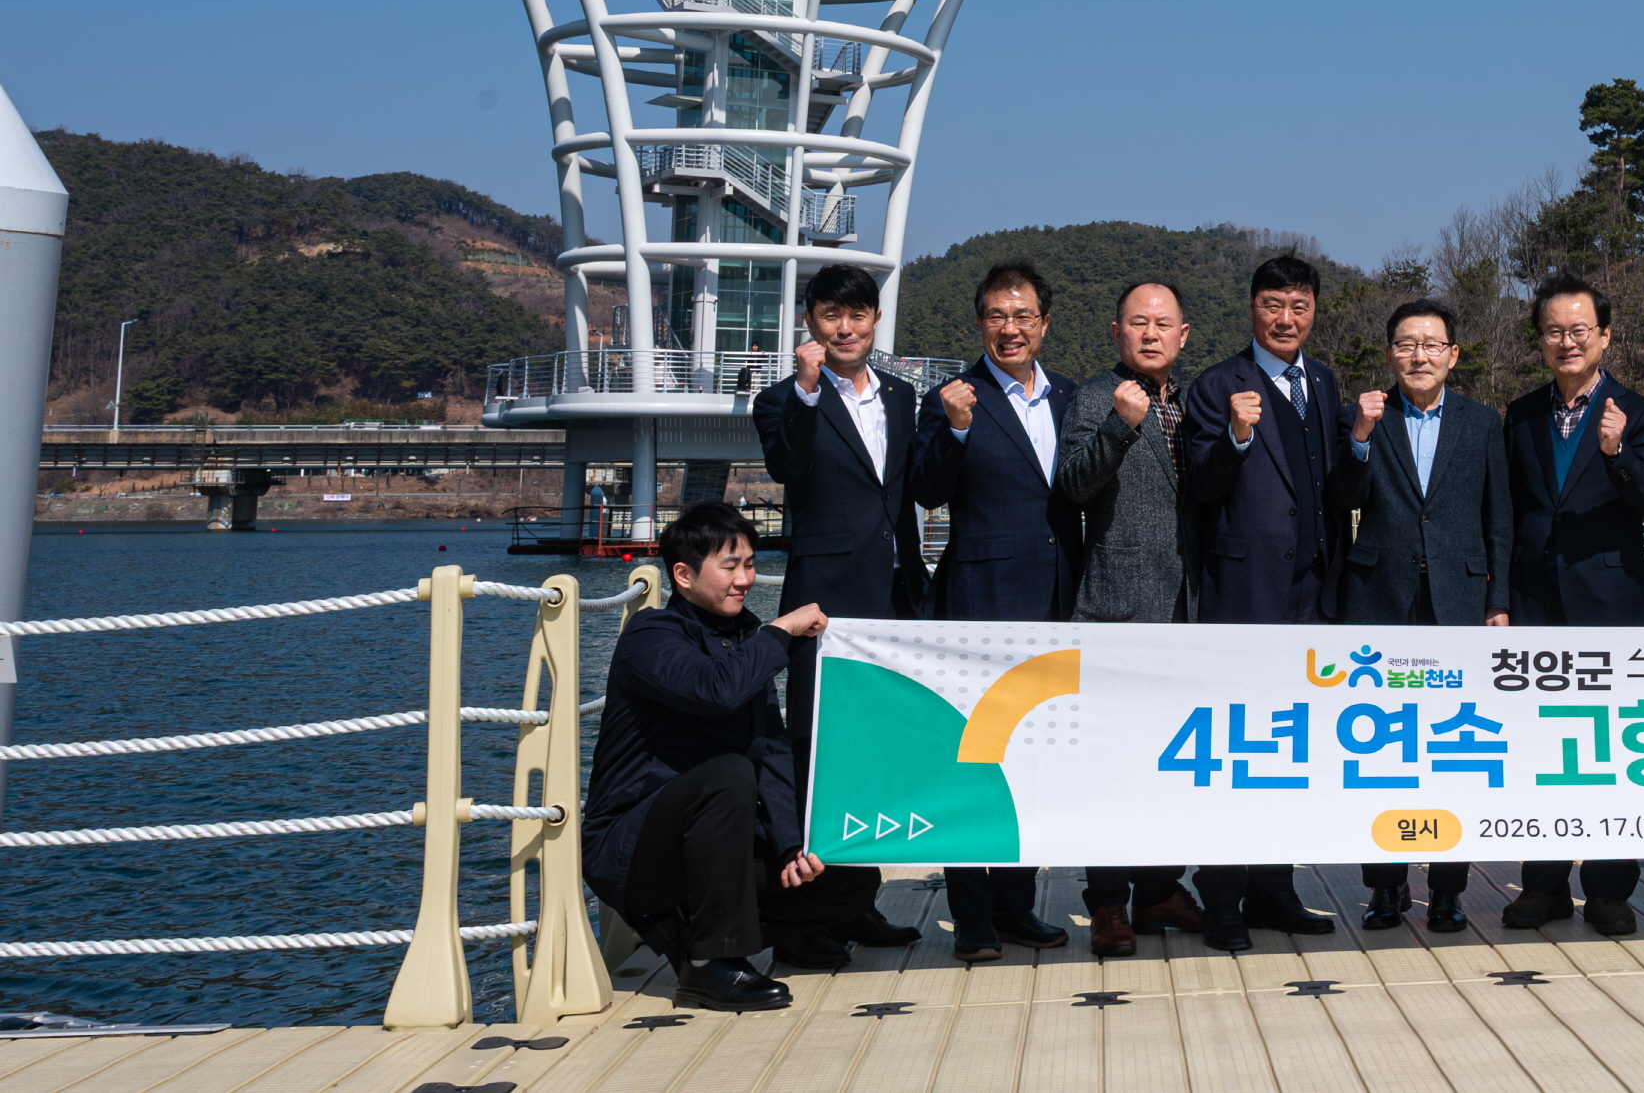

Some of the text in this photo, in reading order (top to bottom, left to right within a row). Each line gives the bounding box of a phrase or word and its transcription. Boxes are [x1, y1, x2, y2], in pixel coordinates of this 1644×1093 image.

[1387, 658, 1439, 667] 국민과 함께하는
[1491, 649, 1613, 691] 청양군
[1387, 669, 1463, 688] 농심천심
[1158, 703, 1309, 789] 4년
[1336, 703, 1508, 789] 연속
[1398, 819, 1437, 840] 일시
[1479, 818, 1547, 837] 2026.
[1555, 818, 1591, 837] 03.
